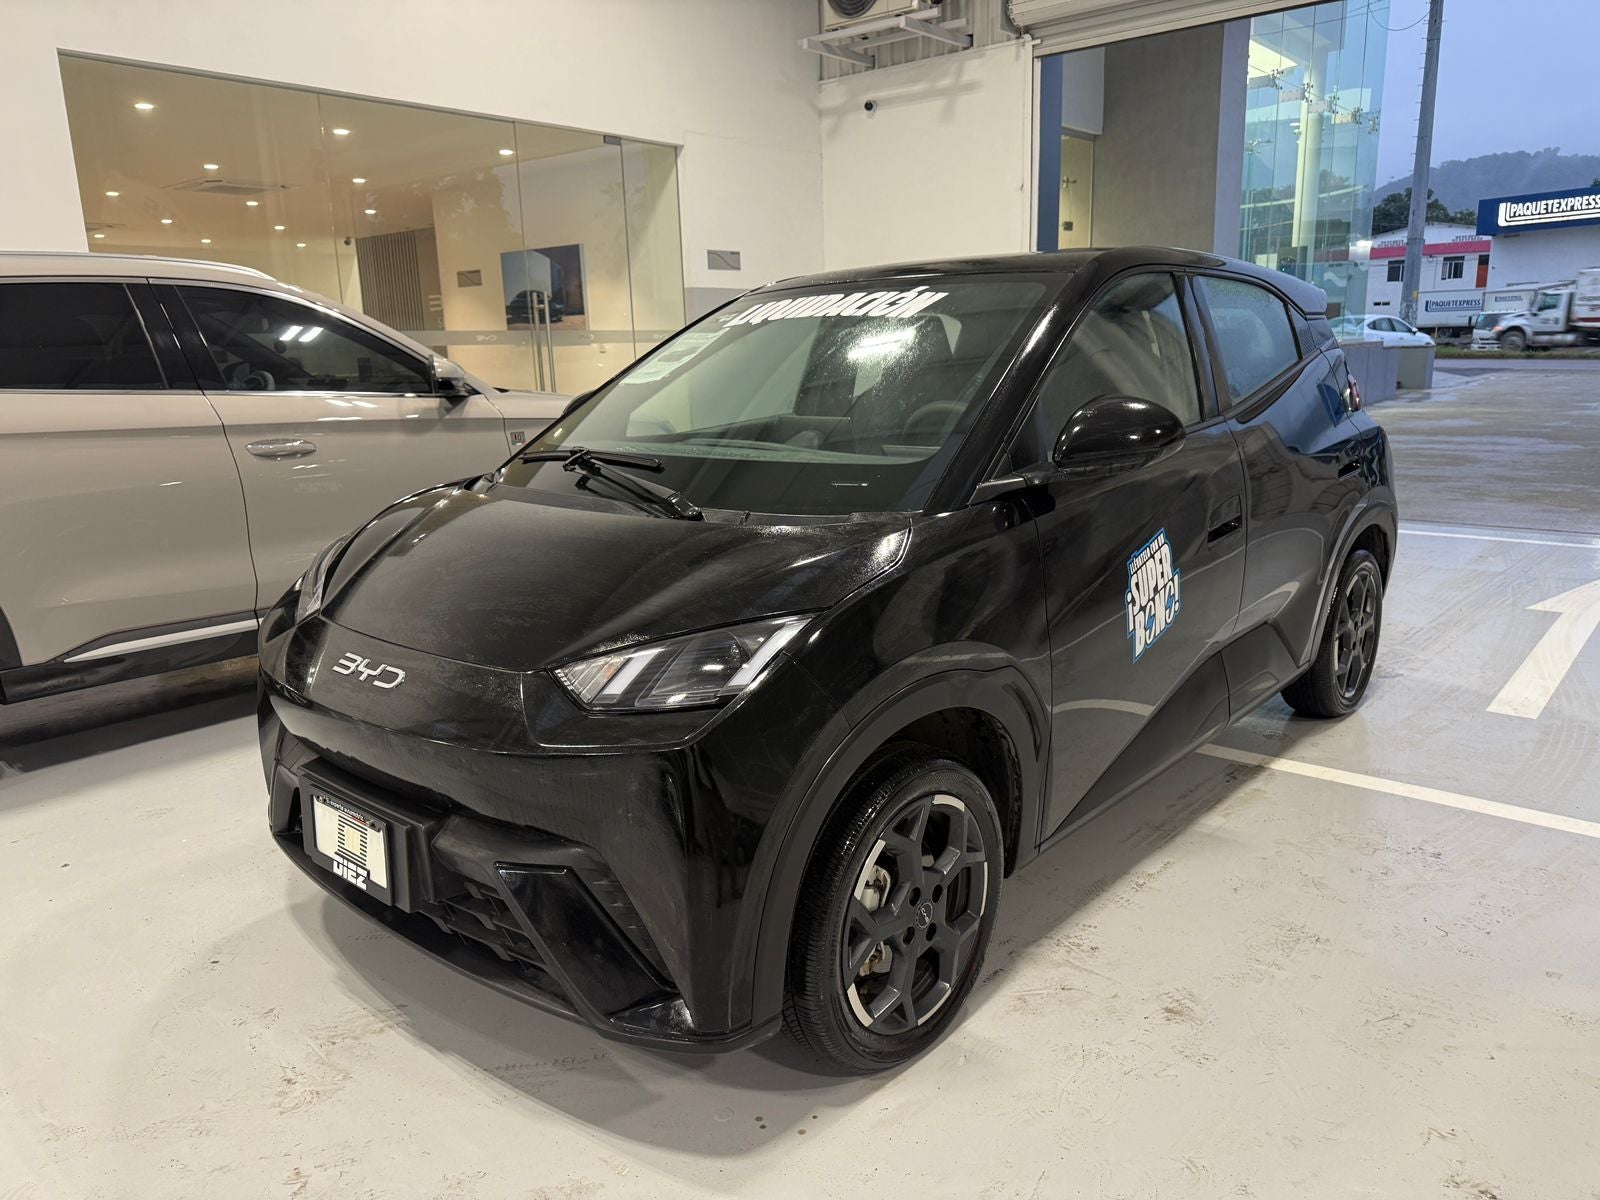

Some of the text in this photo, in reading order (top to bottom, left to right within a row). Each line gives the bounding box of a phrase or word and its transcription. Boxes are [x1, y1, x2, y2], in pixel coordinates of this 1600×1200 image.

[1510, 194, 1600, 217] PAQUETEXPRESS
[722, 285, 949, 327] LIQUIDACIÓN
[1431, 299, 1481, 309] PAQUETEXPRESS
[332, 652, 406, 689] BYD
